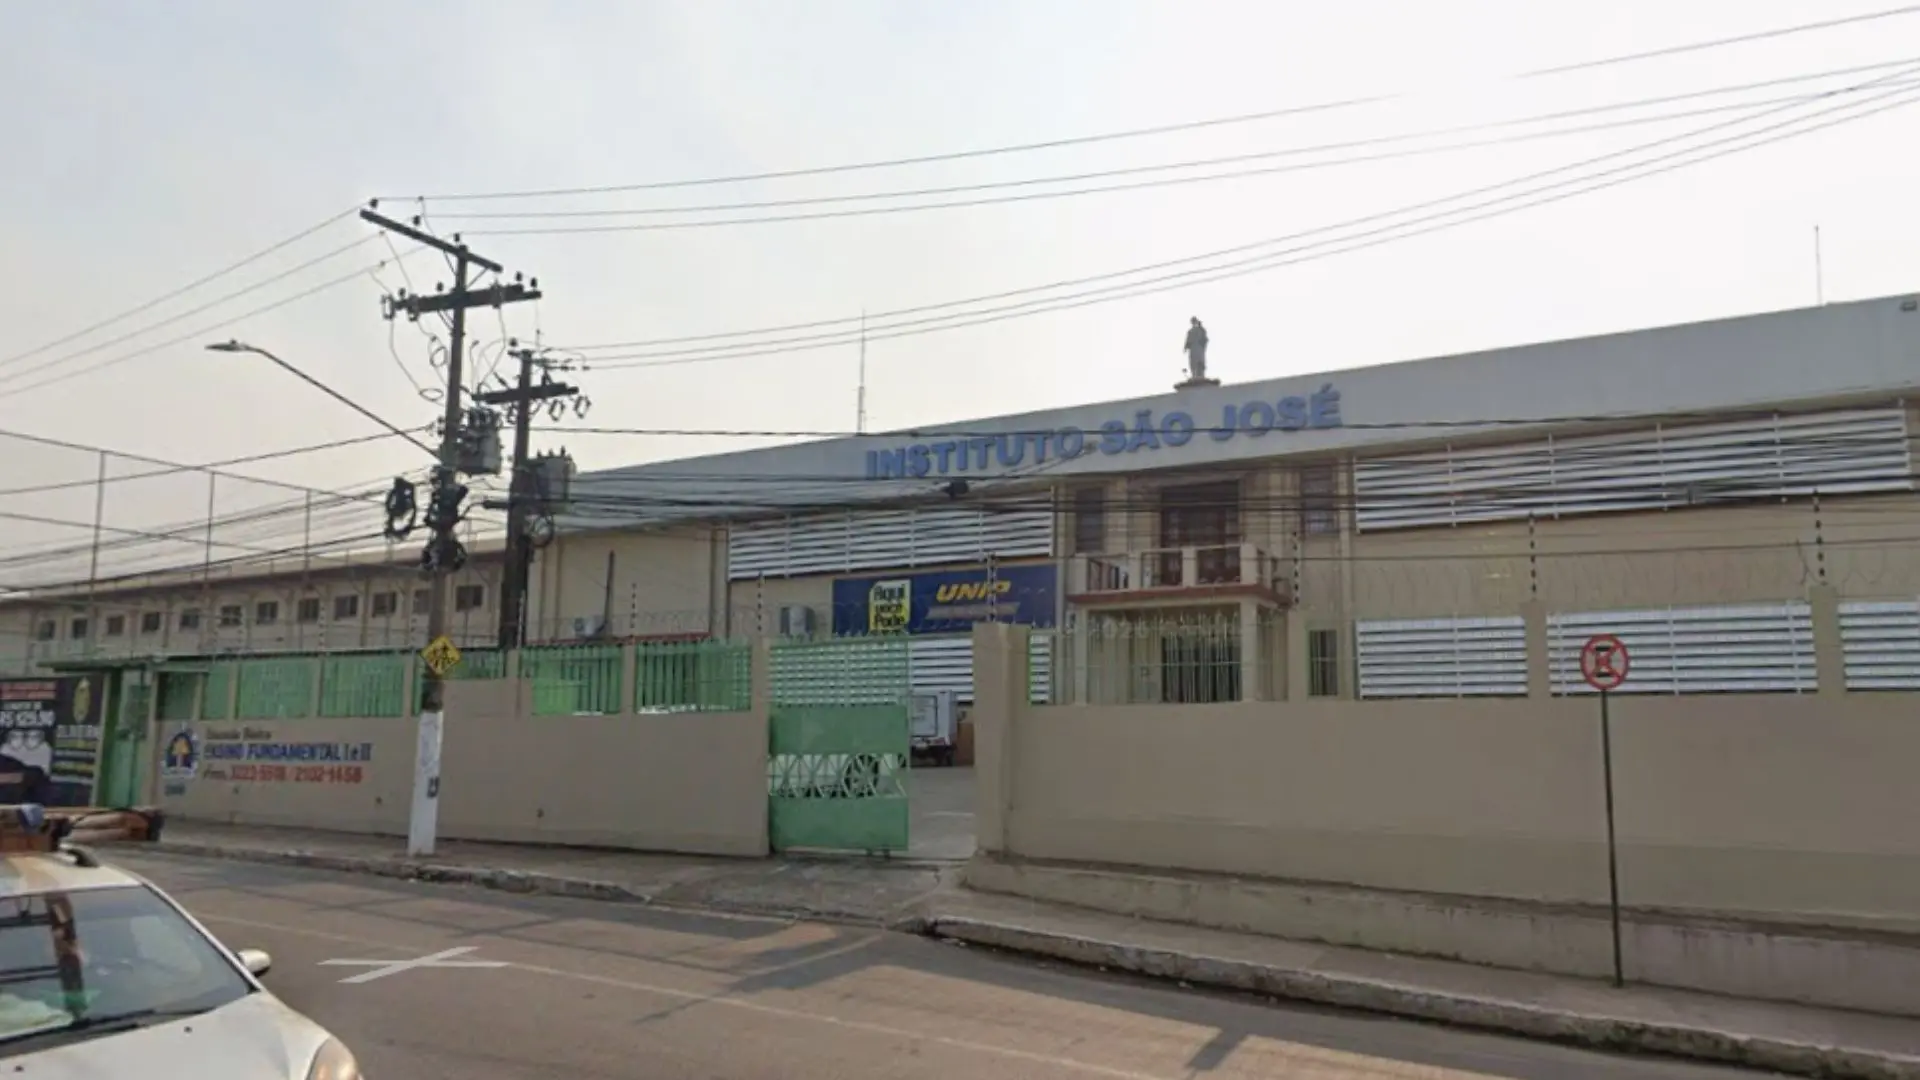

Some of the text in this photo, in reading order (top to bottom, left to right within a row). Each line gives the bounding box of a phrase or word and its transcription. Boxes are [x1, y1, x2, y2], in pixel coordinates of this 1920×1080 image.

[866, 382, 1343, 481] INSTITUTO SÃO JOSÉ
[873, 583, 906, 601] Aqui
[936, 579, 1012, 604] UNIP
[246, 742, 341, 761] FUNDAMENTAL
